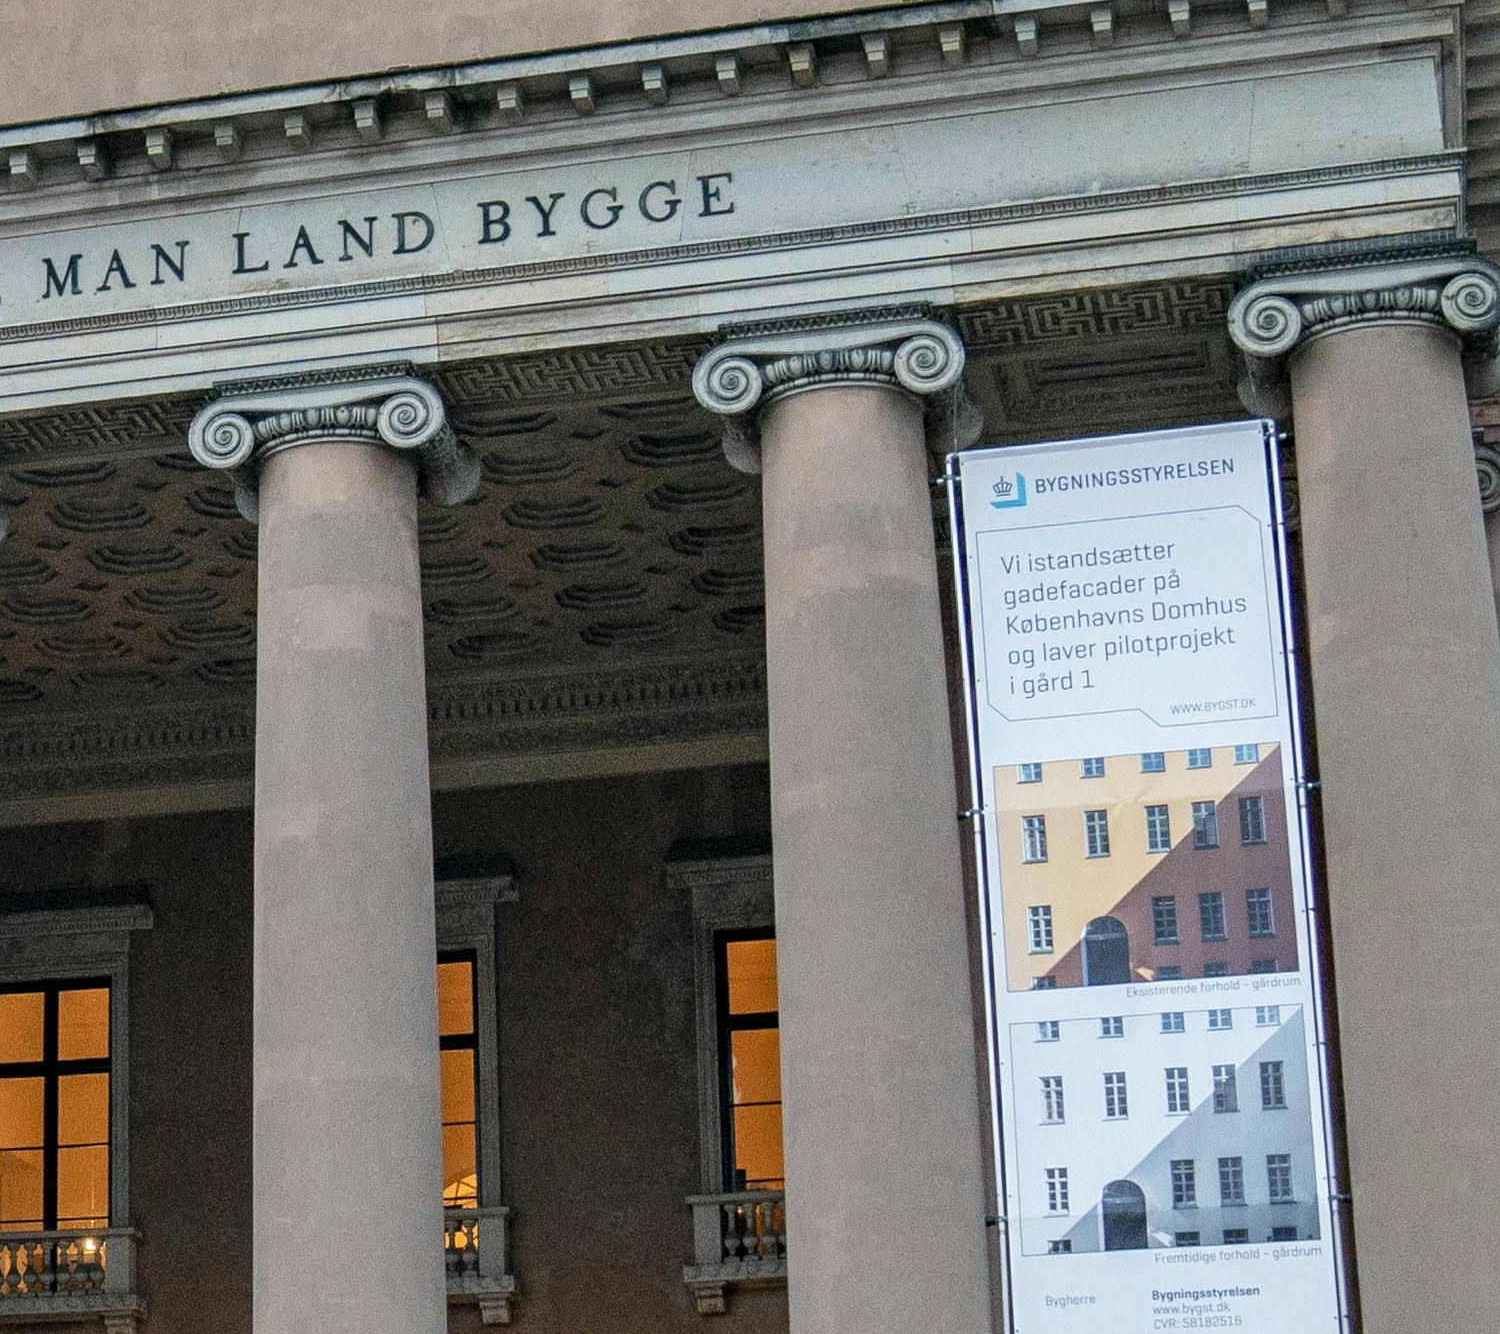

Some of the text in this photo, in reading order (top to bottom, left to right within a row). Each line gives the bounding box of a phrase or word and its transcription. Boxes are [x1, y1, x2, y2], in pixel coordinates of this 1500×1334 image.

[42, 241, 192, 300] MAN
[232, 211, 434, 275] LAND
[478, 172, 734, 244] BYGGE
[1035, 458, 1235, 493] BYGNINGSSTYRELSEN
[1000, 543, 1175, 574] Vi istandsætter
[1004, 569, 1181, 610] gadefacader på
[1006, 597, 1247, 635] Københavns Domhus
[1008, 626, 1236, 669] og laver pilotprojekt
[1009, 669, 1095, 699] i gård 1
[1169, 697, 1257, 715] WWW.BYGST.DK
[1126, 982, 1197, 998] Eksisterende
[1200, 979, 1240, 993] forhold
[1252, 976, 1300, 991] gårdrum
[1154, 1250, 1216, 1264] Fremtidige
[1219, 1247, 1260, 1262] forhold
[1272, 1245, 1322, 1260] gårdrum
[1045, 1294, 1096, 1308] Bygherre
[1152, 1286, 1260, 1302] Bygningsstyrelsen
[1152, 1301, 1231, 1316] www.bygst.dk
